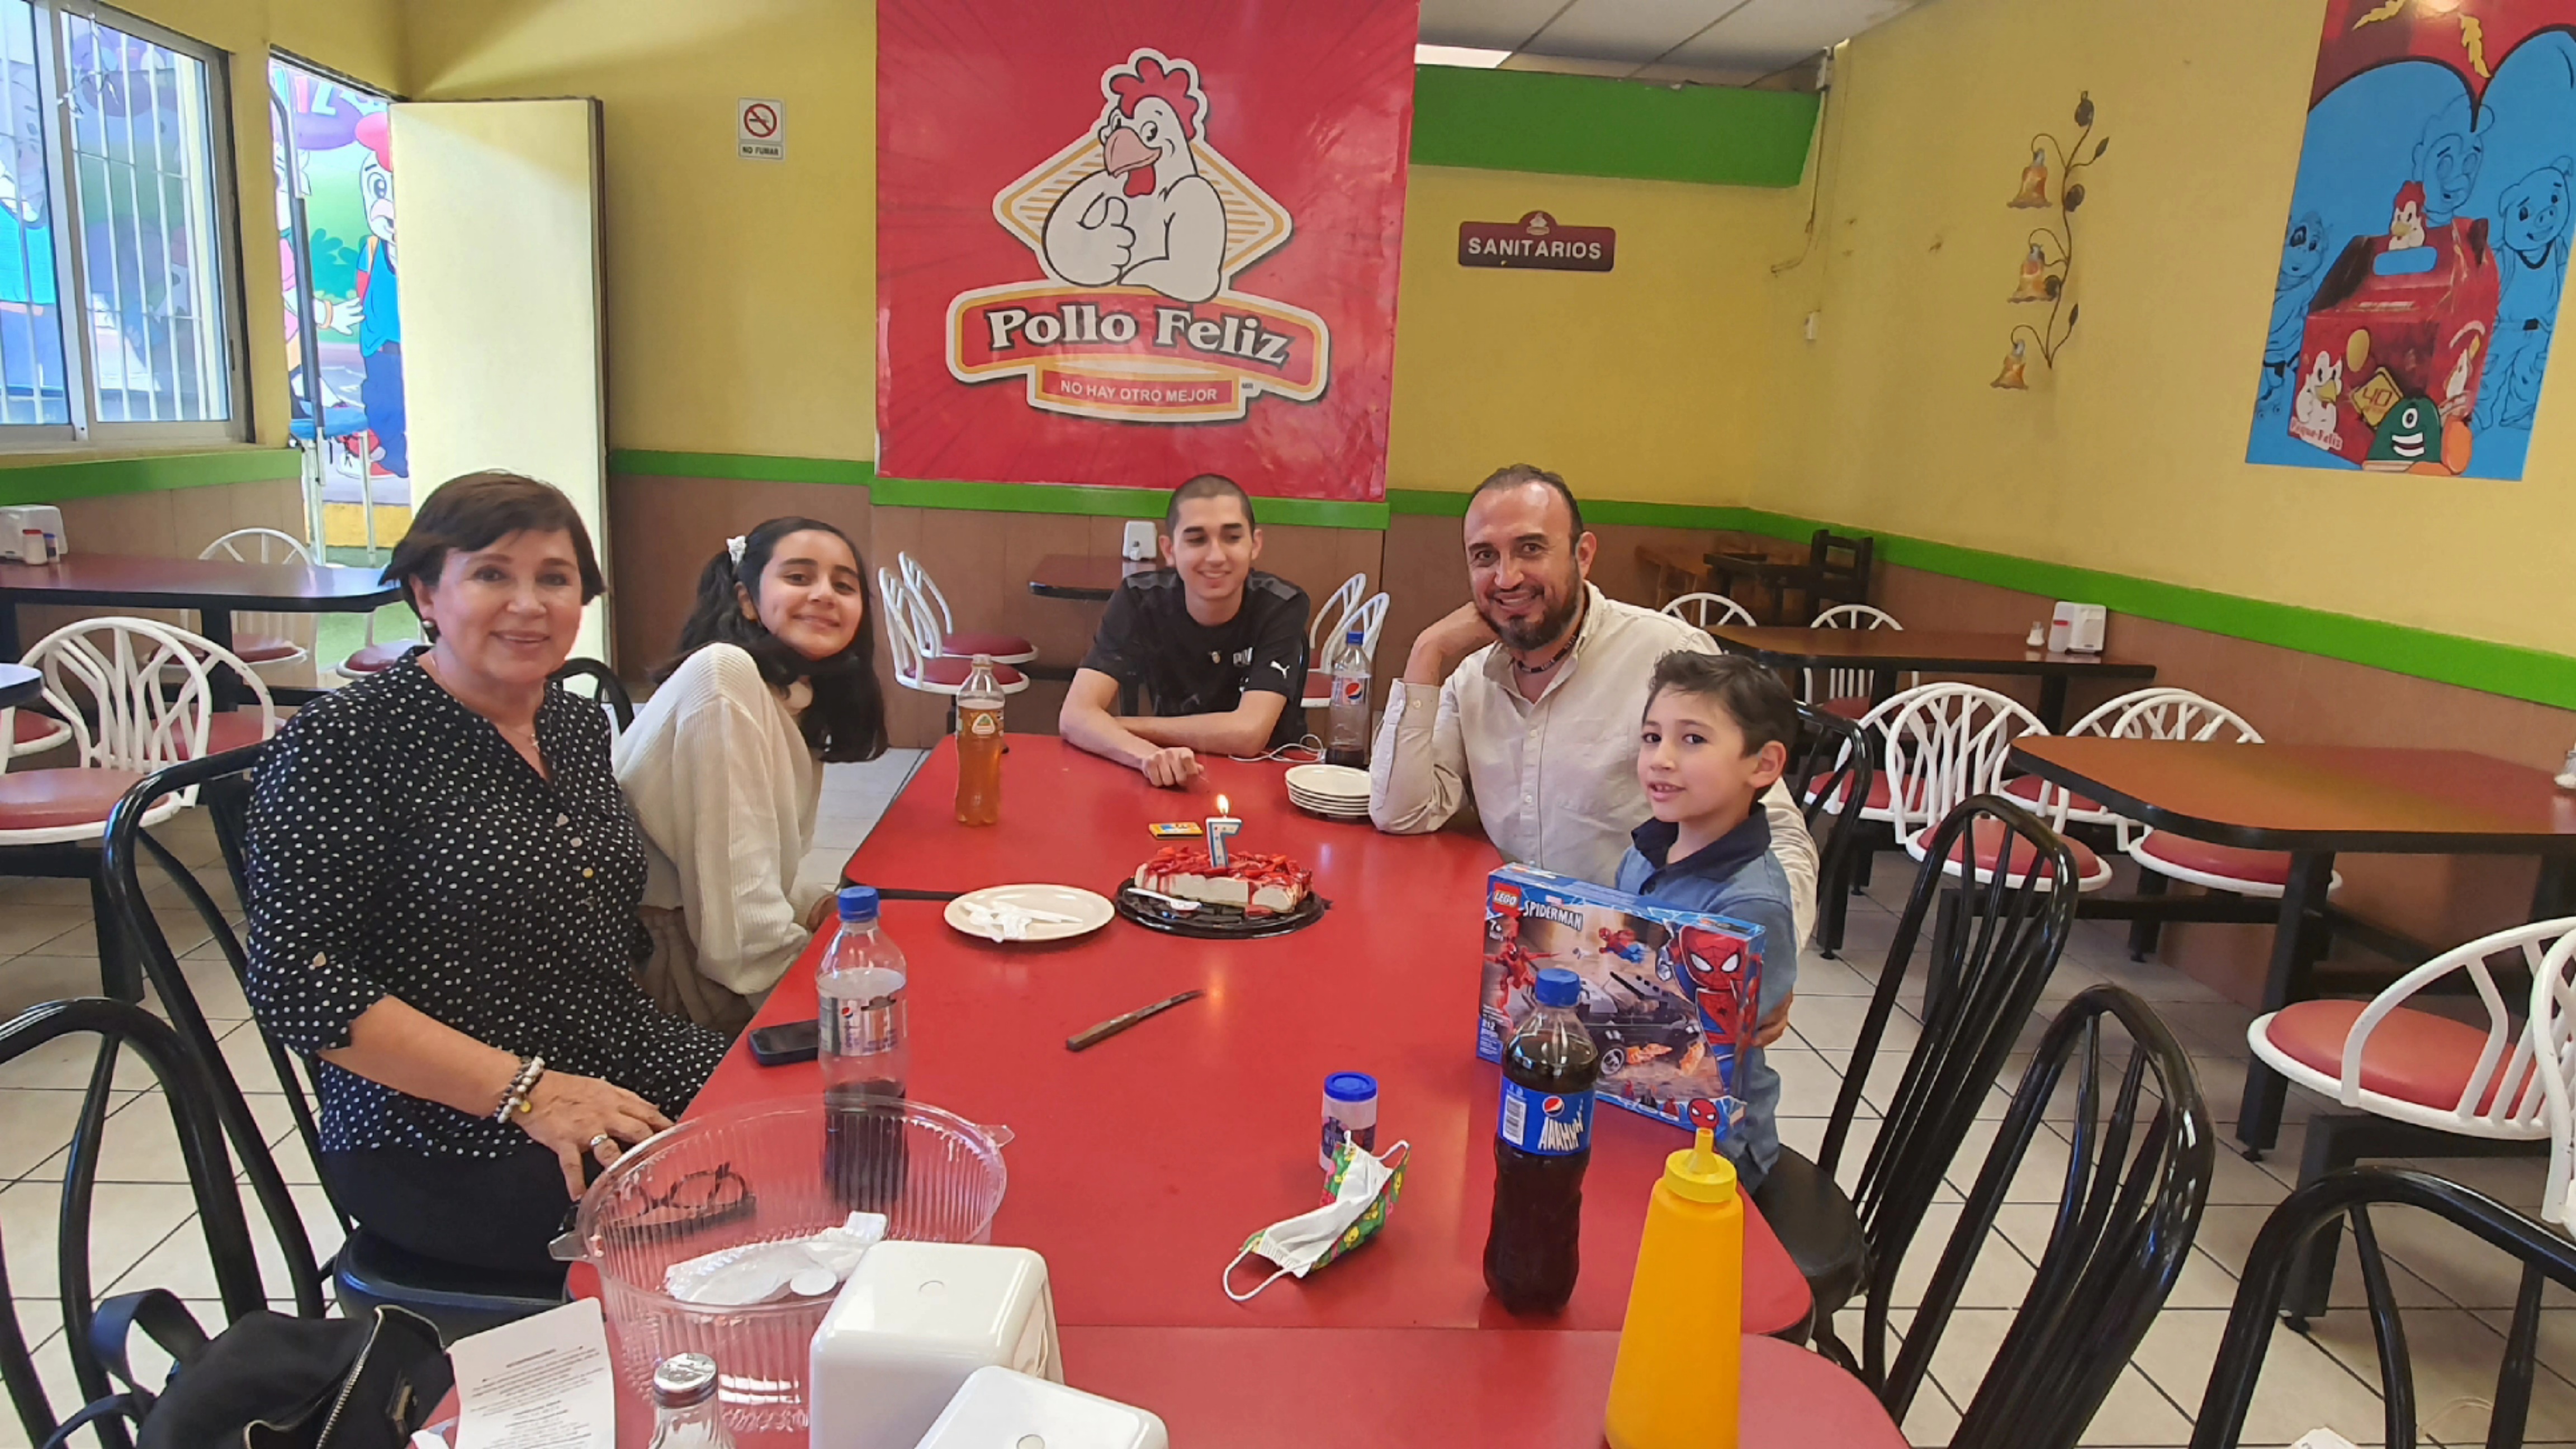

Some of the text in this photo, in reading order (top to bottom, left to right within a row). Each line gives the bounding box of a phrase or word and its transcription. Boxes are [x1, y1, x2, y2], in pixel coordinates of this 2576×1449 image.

[1468, 237, 1602, 259] SANITARIOS
[987, 305, 1288, 364] Pollo Feliz
[1060, 380, 1218, 402] NO HAY OTRO MEJOR
[1494, 891, 1518, 907] LEGO
[1522, 901, 1584, 932] SPIDERMAN
